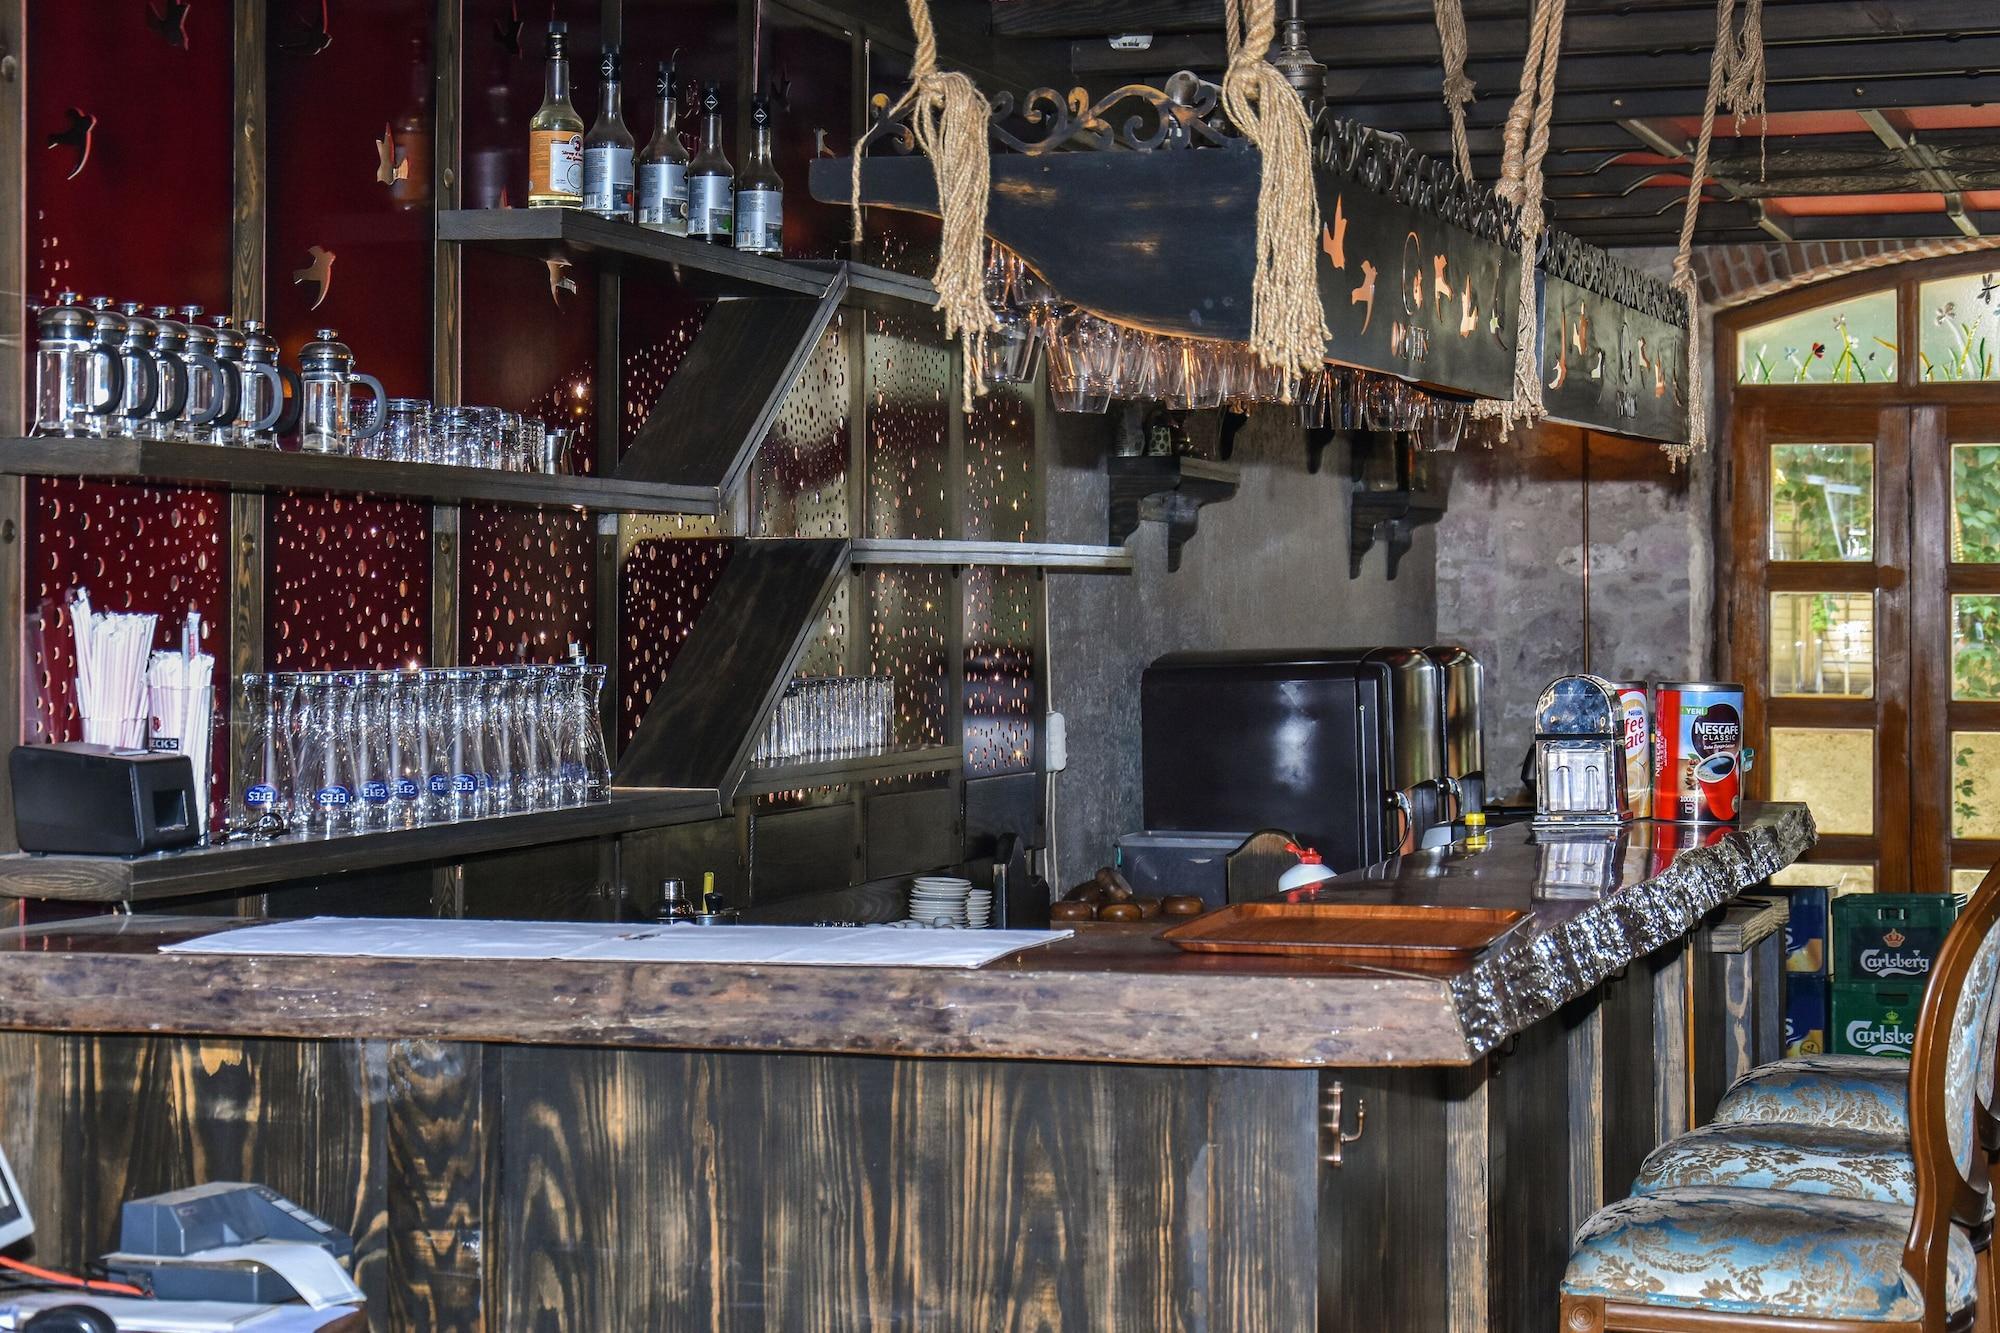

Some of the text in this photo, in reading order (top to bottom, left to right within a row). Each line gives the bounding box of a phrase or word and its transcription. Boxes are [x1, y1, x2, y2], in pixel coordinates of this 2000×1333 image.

[1625, 716, 1644, 735] fee
[151, 739, 177, 749] ECK'S
[1625, 731, 1645, 750] ate
[247, 791, 274, 802] EFES
[319, 792, 346, 803] EFES
[1859, 949, 1930, 977] Carlsberg
[1846, 1020, 1914, 1051] Carlsbe
